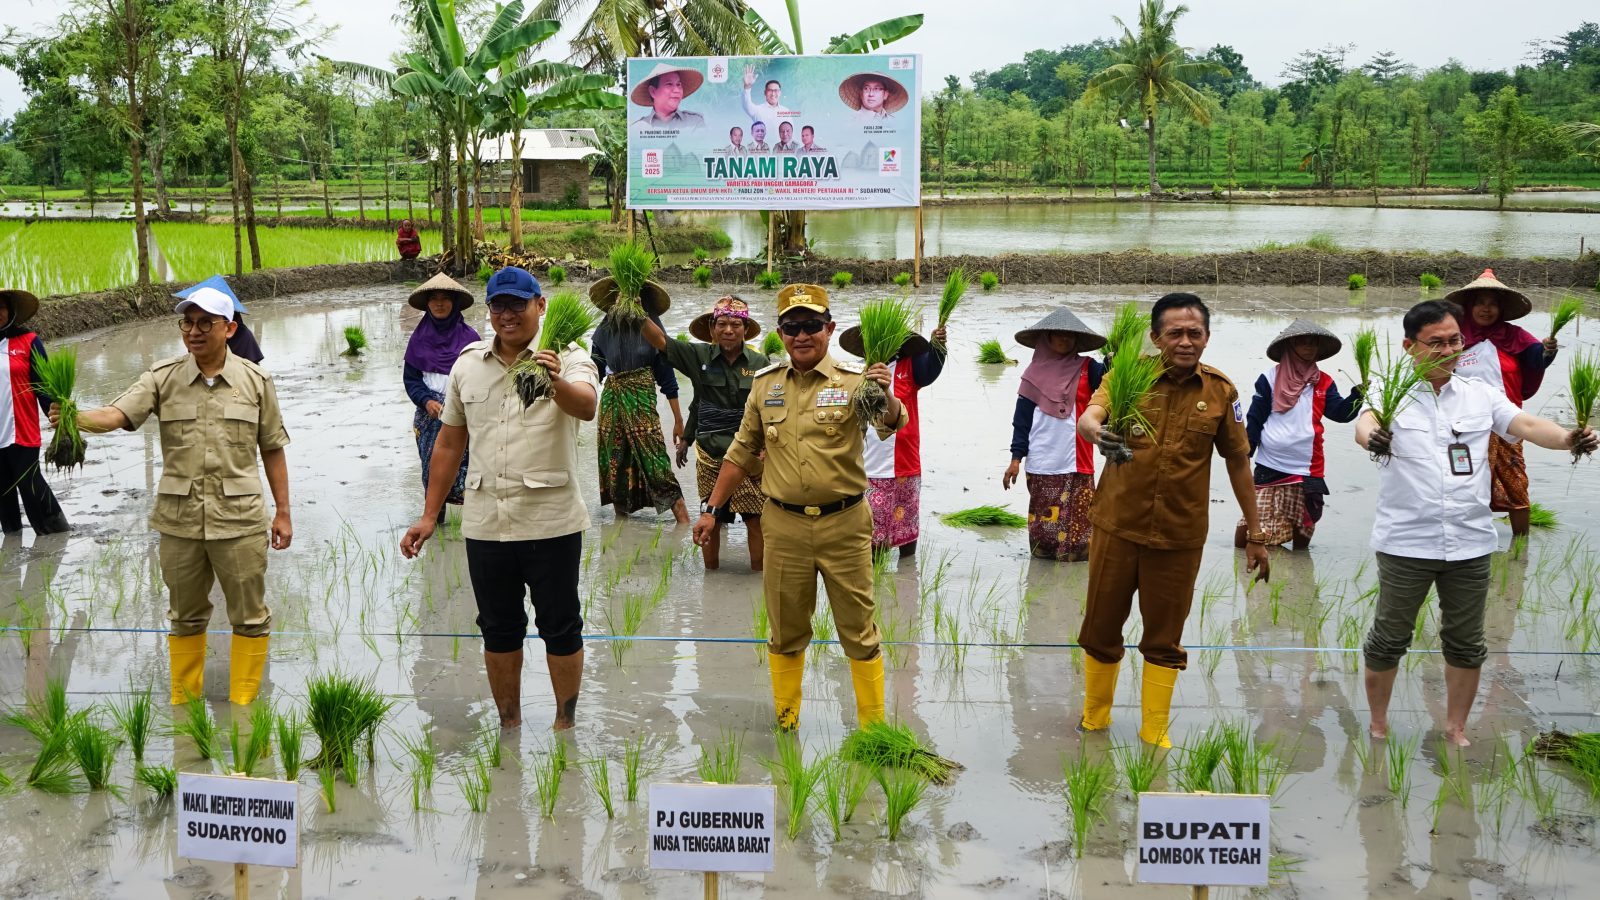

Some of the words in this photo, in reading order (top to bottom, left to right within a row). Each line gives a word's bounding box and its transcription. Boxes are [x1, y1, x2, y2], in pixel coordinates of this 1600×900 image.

[704, 157, 776, 179] TANAM
[783, 156, 838, 178] RAYA
[183, 792, 208, 813] WAKIL
[210, 795, 246, 817] MENTERI
[248, 798, 294, 820] PERTANIAN
[657, 810, 675, 828] PJ
[679, 811, 765, 829] GUBERNUR
[187, 821, 287, 845] SUDARYONO
[1143, 822, 1260, 839] BUPATI
[653, 834, 681, 852] NUSA
[682, 836, 735, 853] TENGGARA
[738, 837, 770, 853] BARAT
[1140, 847, 1205, 864] LOMBOK
[1209, 848, 1261, 864] TEGAH
